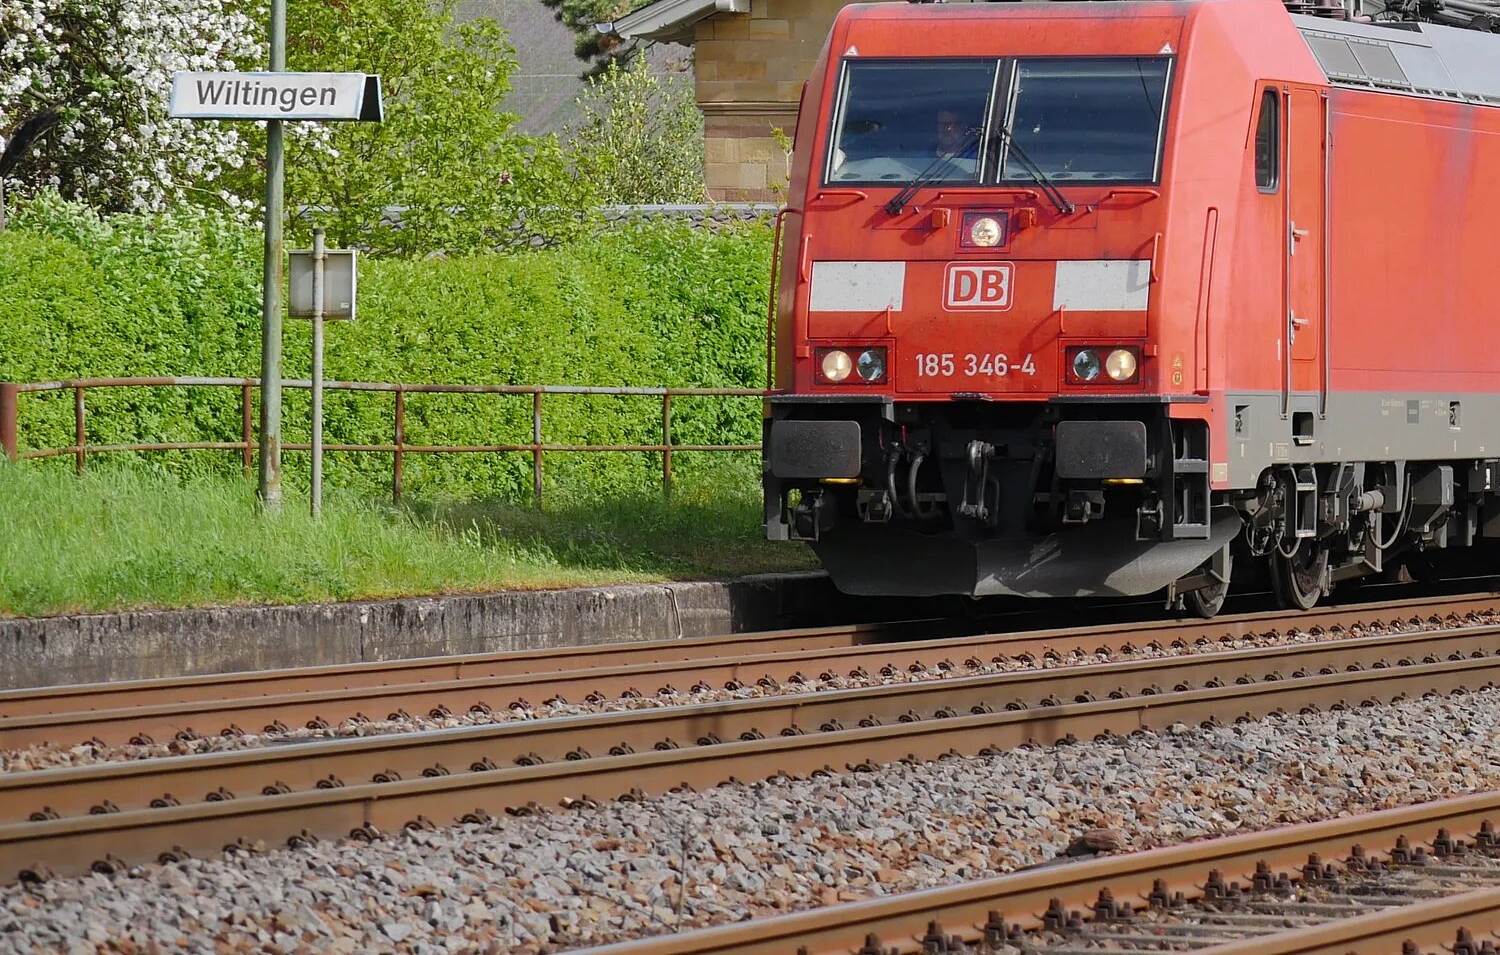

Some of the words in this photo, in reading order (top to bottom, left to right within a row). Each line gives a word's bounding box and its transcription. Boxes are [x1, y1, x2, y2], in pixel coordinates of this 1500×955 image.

[196, 80, 337, 112] Wiltingen
[951, 269, 1006, 304] DB
[916, 353, 955, 376] 185
[964, 353, 1036, 376] 346-4
